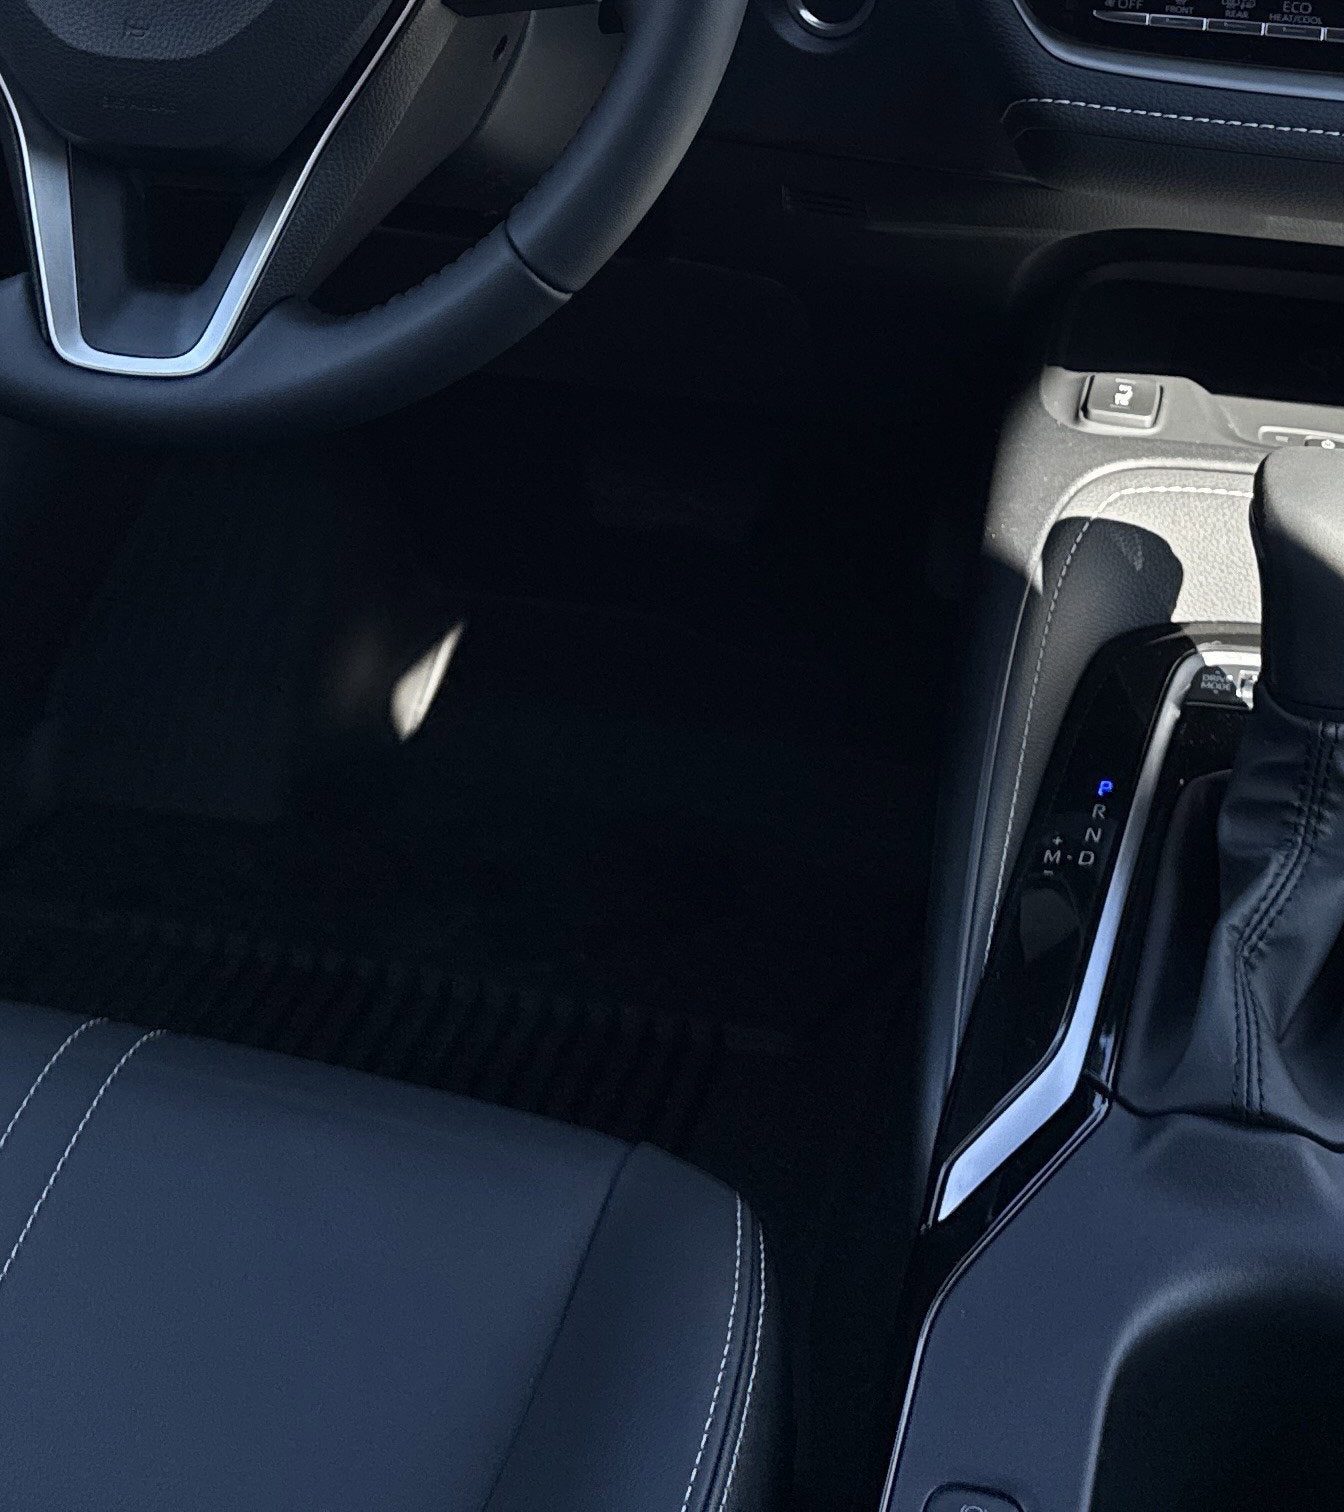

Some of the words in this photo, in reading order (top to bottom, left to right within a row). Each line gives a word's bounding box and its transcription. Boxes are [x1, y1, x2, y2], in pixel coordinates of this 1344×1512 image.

[1165, 4, 1194, 15] FRONT
[1225, 10, 1249, 19] REAR
[1282, 0, 1313, 14] ECO
[1269, 13, 1323, 26] HEAT/COOL
[1097, 780, 1113, 796] P
[1091, 803, 1106, 819] R
[1084, 827, 1102, 843] N
[1043, 849, 1061, 865] M
[1078, 850, 1095, 866] D
